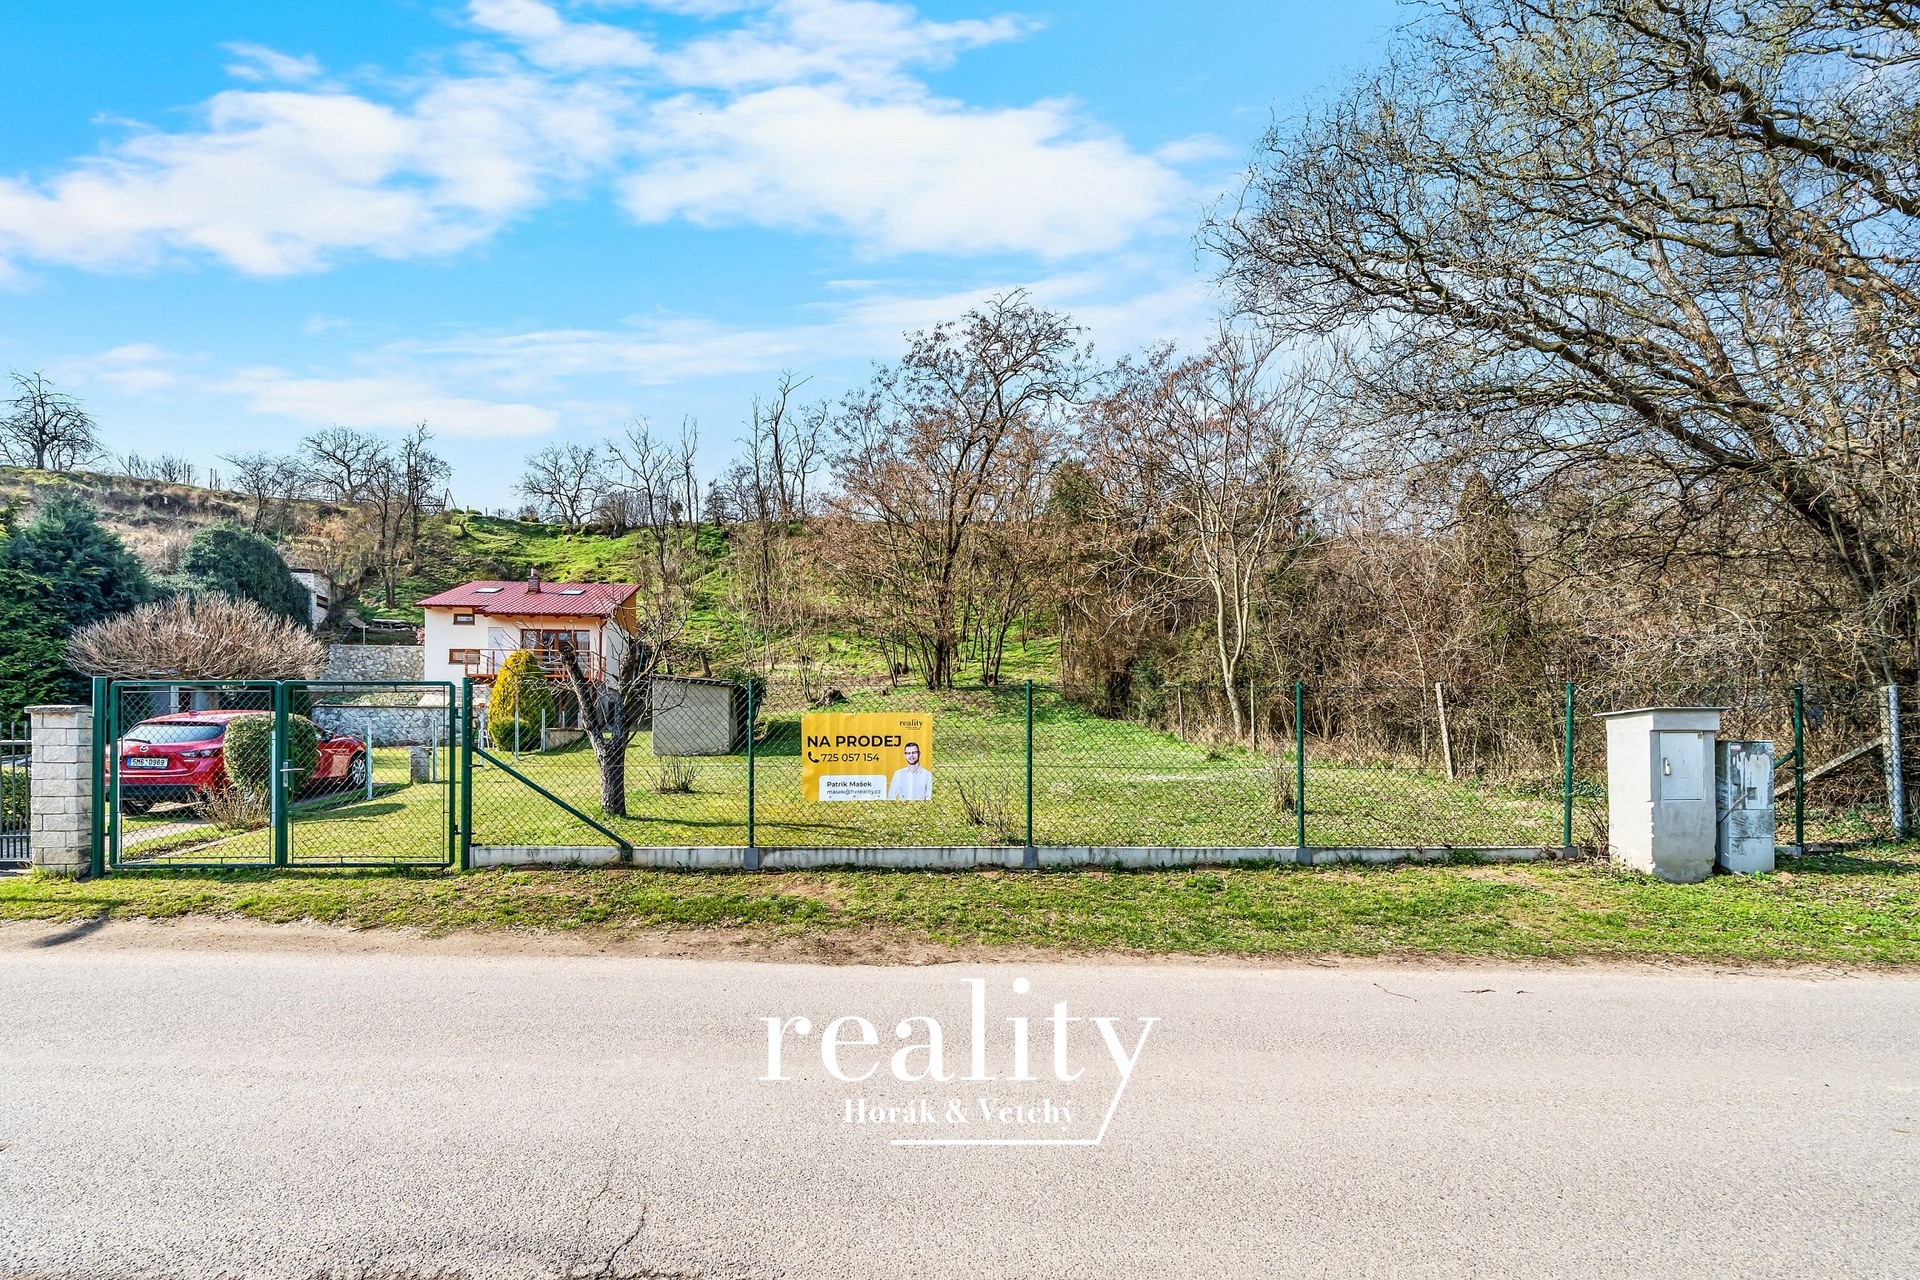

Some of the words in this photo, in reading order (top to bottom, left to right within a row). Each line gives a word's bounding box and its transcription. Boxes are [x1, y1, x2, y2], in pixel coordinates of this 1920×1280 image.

[899, 718, 924, 730] reality
[807, 735, 831, 748] NA
[836, 735, 902, 747] PRODEJ
[820, 753, 839, 762] 725
[841, 753, 860, 762] 057
[863, 753, 880, 762] 154
[826, 780, 848, 788] Patrik
[849, 780, 872, 788] Mašek
